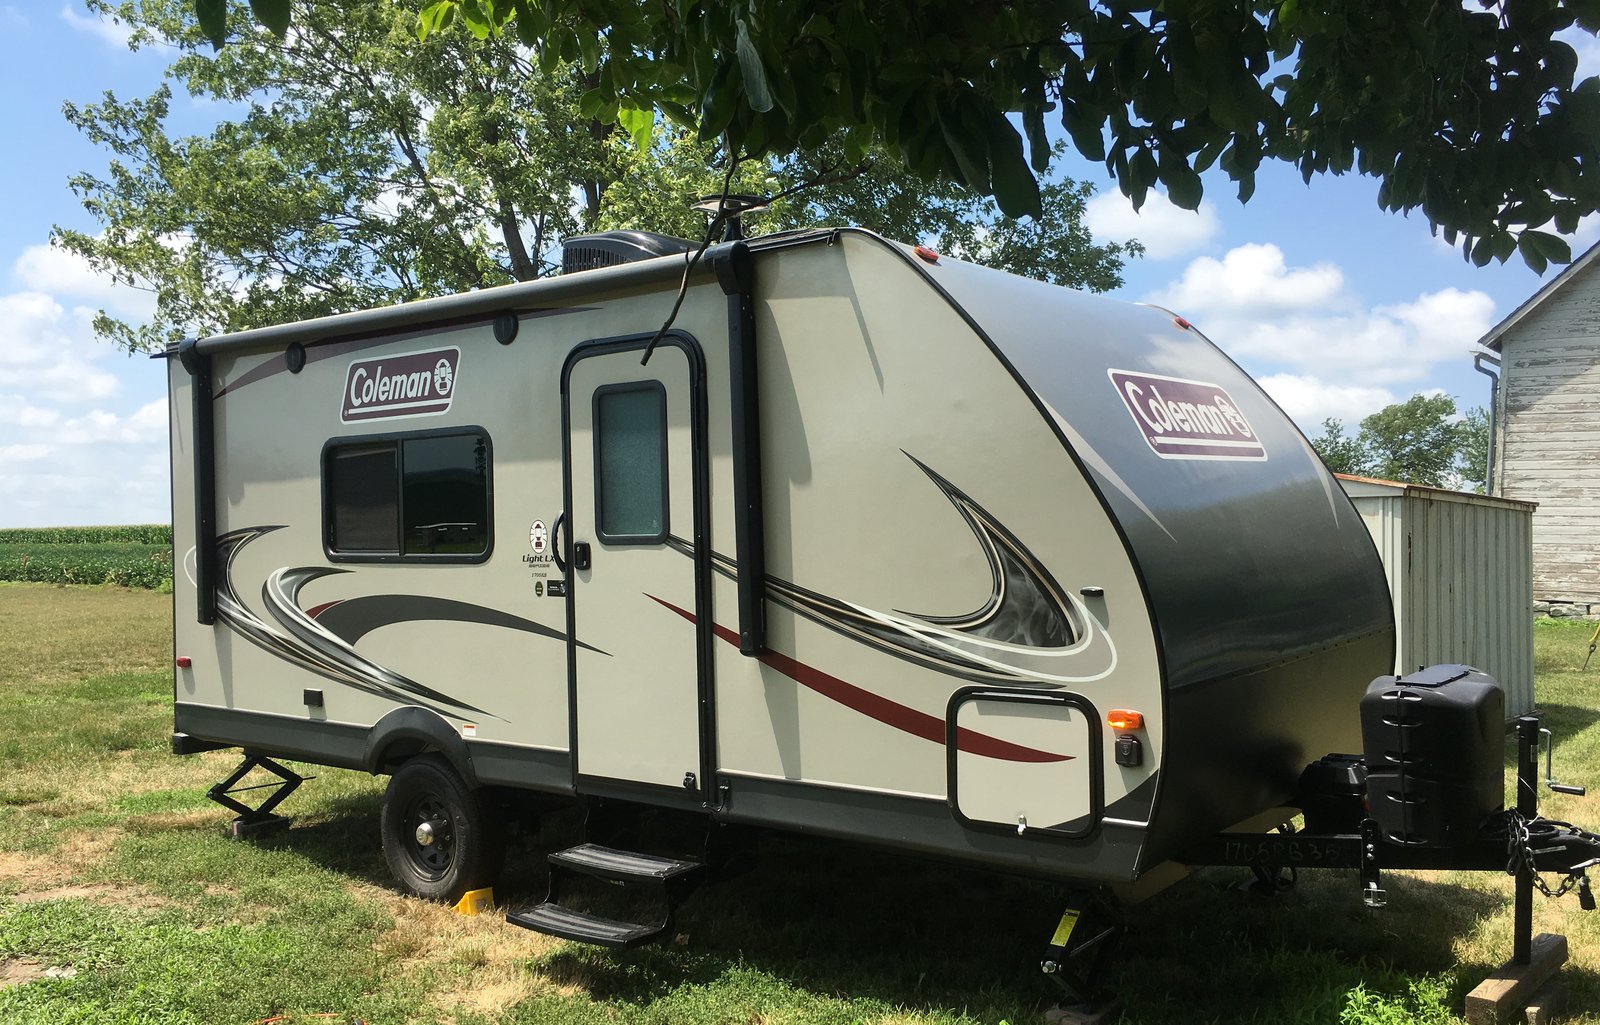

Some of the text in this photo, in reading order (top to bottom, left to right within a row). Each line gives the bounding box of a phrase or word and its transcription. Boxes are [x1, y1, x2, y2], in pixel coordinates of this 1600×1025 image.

[351, 366, 431, 407] Coleman
[1124, 381, 1234, 435] Coleman
[522, 554, 544, 564] Light
